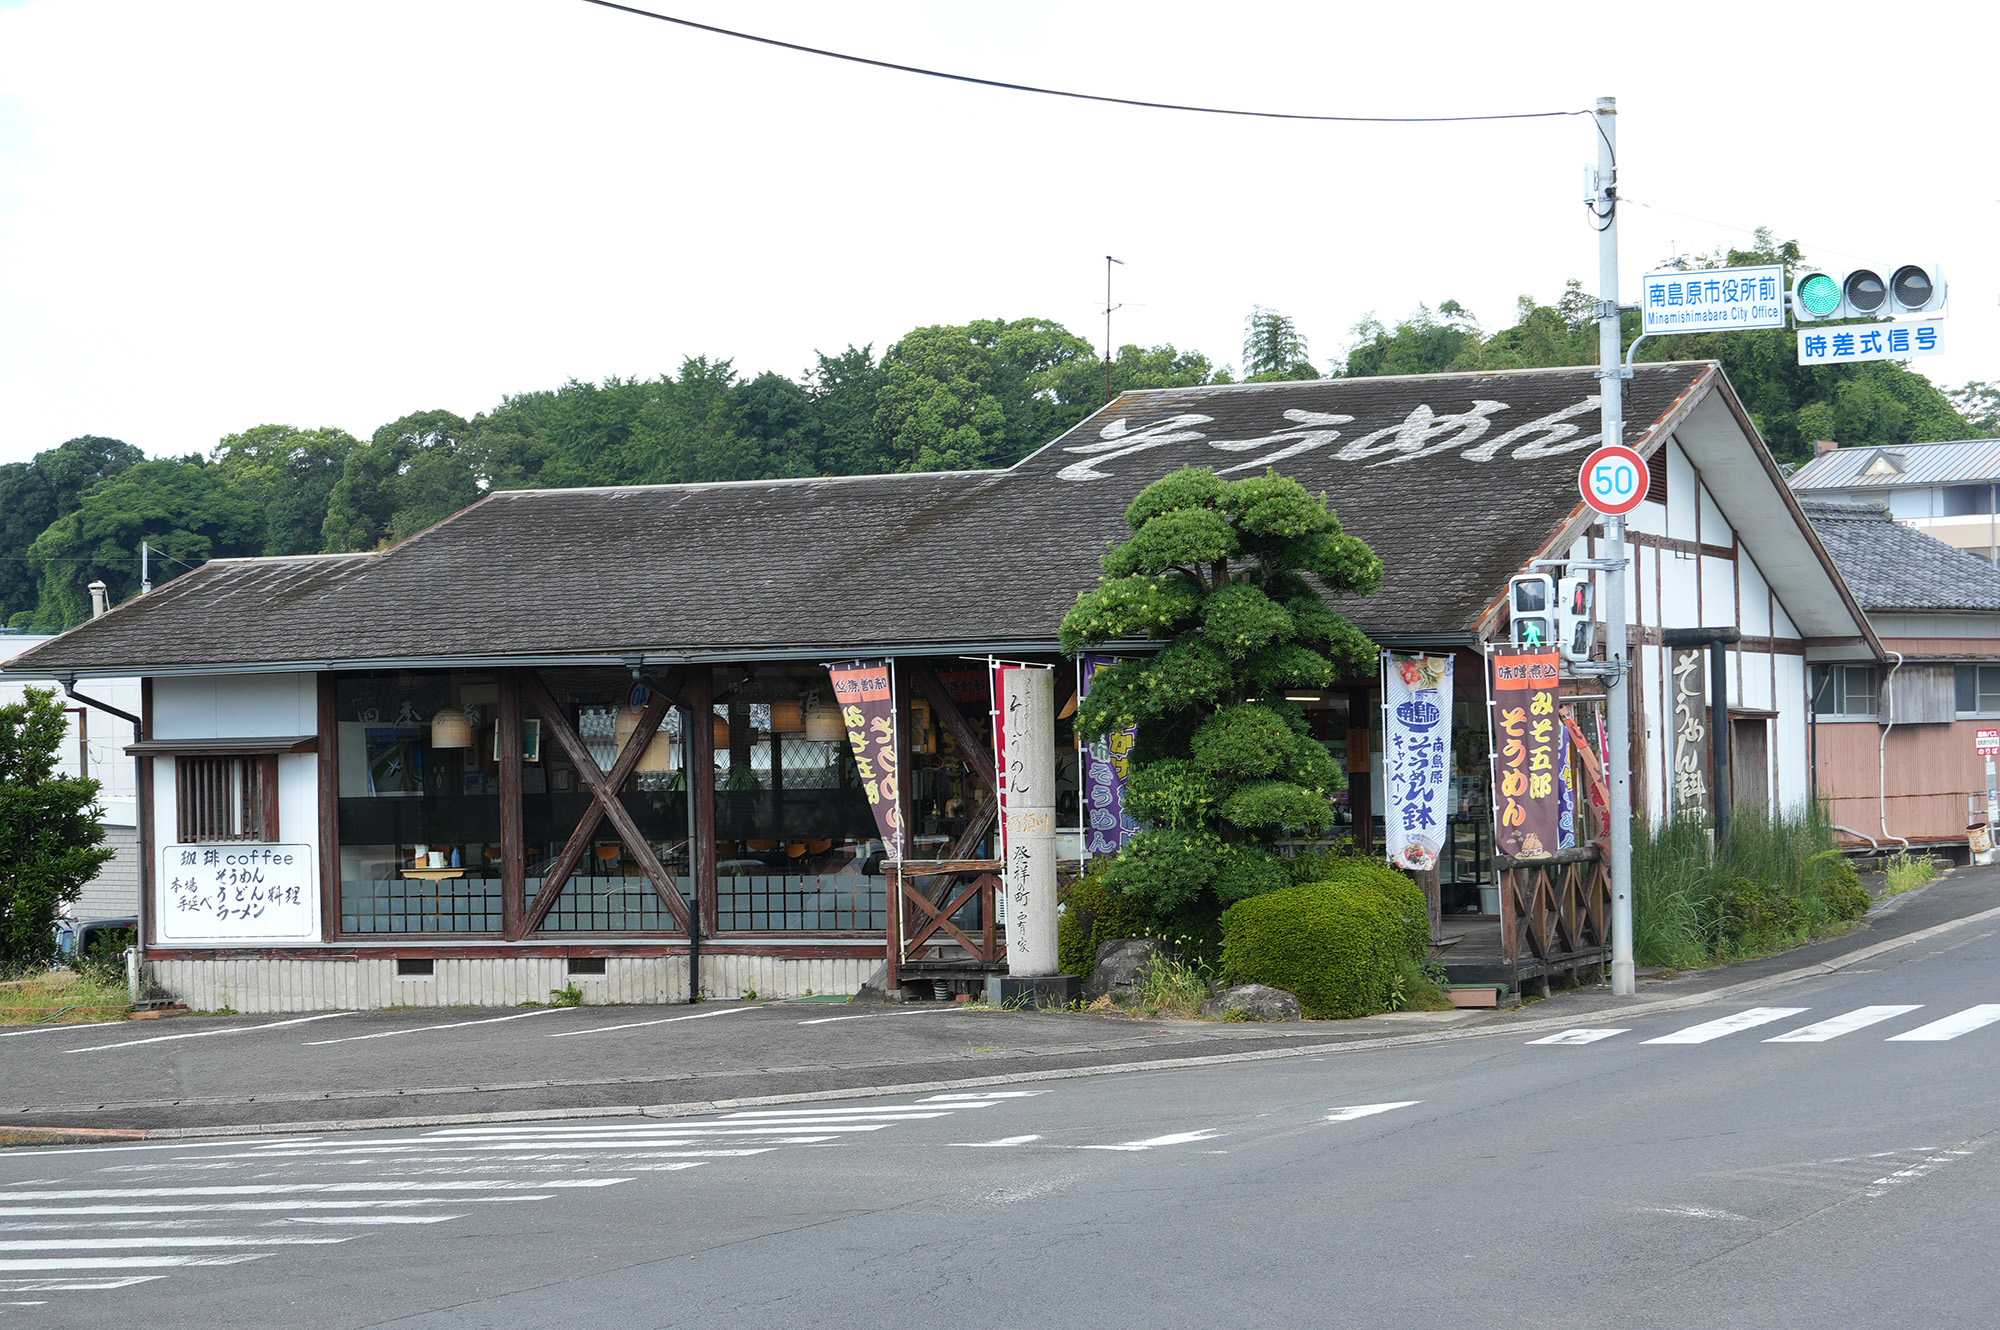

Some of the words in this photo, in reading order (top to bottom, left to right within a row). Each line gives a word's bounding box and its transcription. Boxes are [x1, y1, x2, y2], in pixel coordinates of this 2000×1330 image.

[1649, 276, 1776, 308] 南島原市役所前
[1648, 310, 1727, 325] Minamishimabara
[1731, 306, 1748, 322] City
[1752, 305, 1778, 319] Office
[1805, 327, 1937, 357] 時差式信号
[1056, 395, 1626, 482] そうめん
[1595, 466, 1633, 495] 50
[1498, 664, 1557, 680] 味噌煮込
[1529, 691, 1554, 799] みそ五郎
[1391, 733, 1406, 806] キャンペーン
[1430, 736, 1444, 784] 南島原
[1500, 706, 1528, 827] そうめん
[1401, 736, 1436, 831] そうめん鉢
[180, 849, 220, 868] 珈琲
[226, 849, 293, 865] coffee
[170, 877, 198, 893] 本場
[215, 867, 264, 885] そうめん
[177, 895, 212, 912] 手延べ
[217, 886, 264, 903] うどん
[268, 885, 301, 906] 料理
[216, 903, 265, 921] ラーメン
